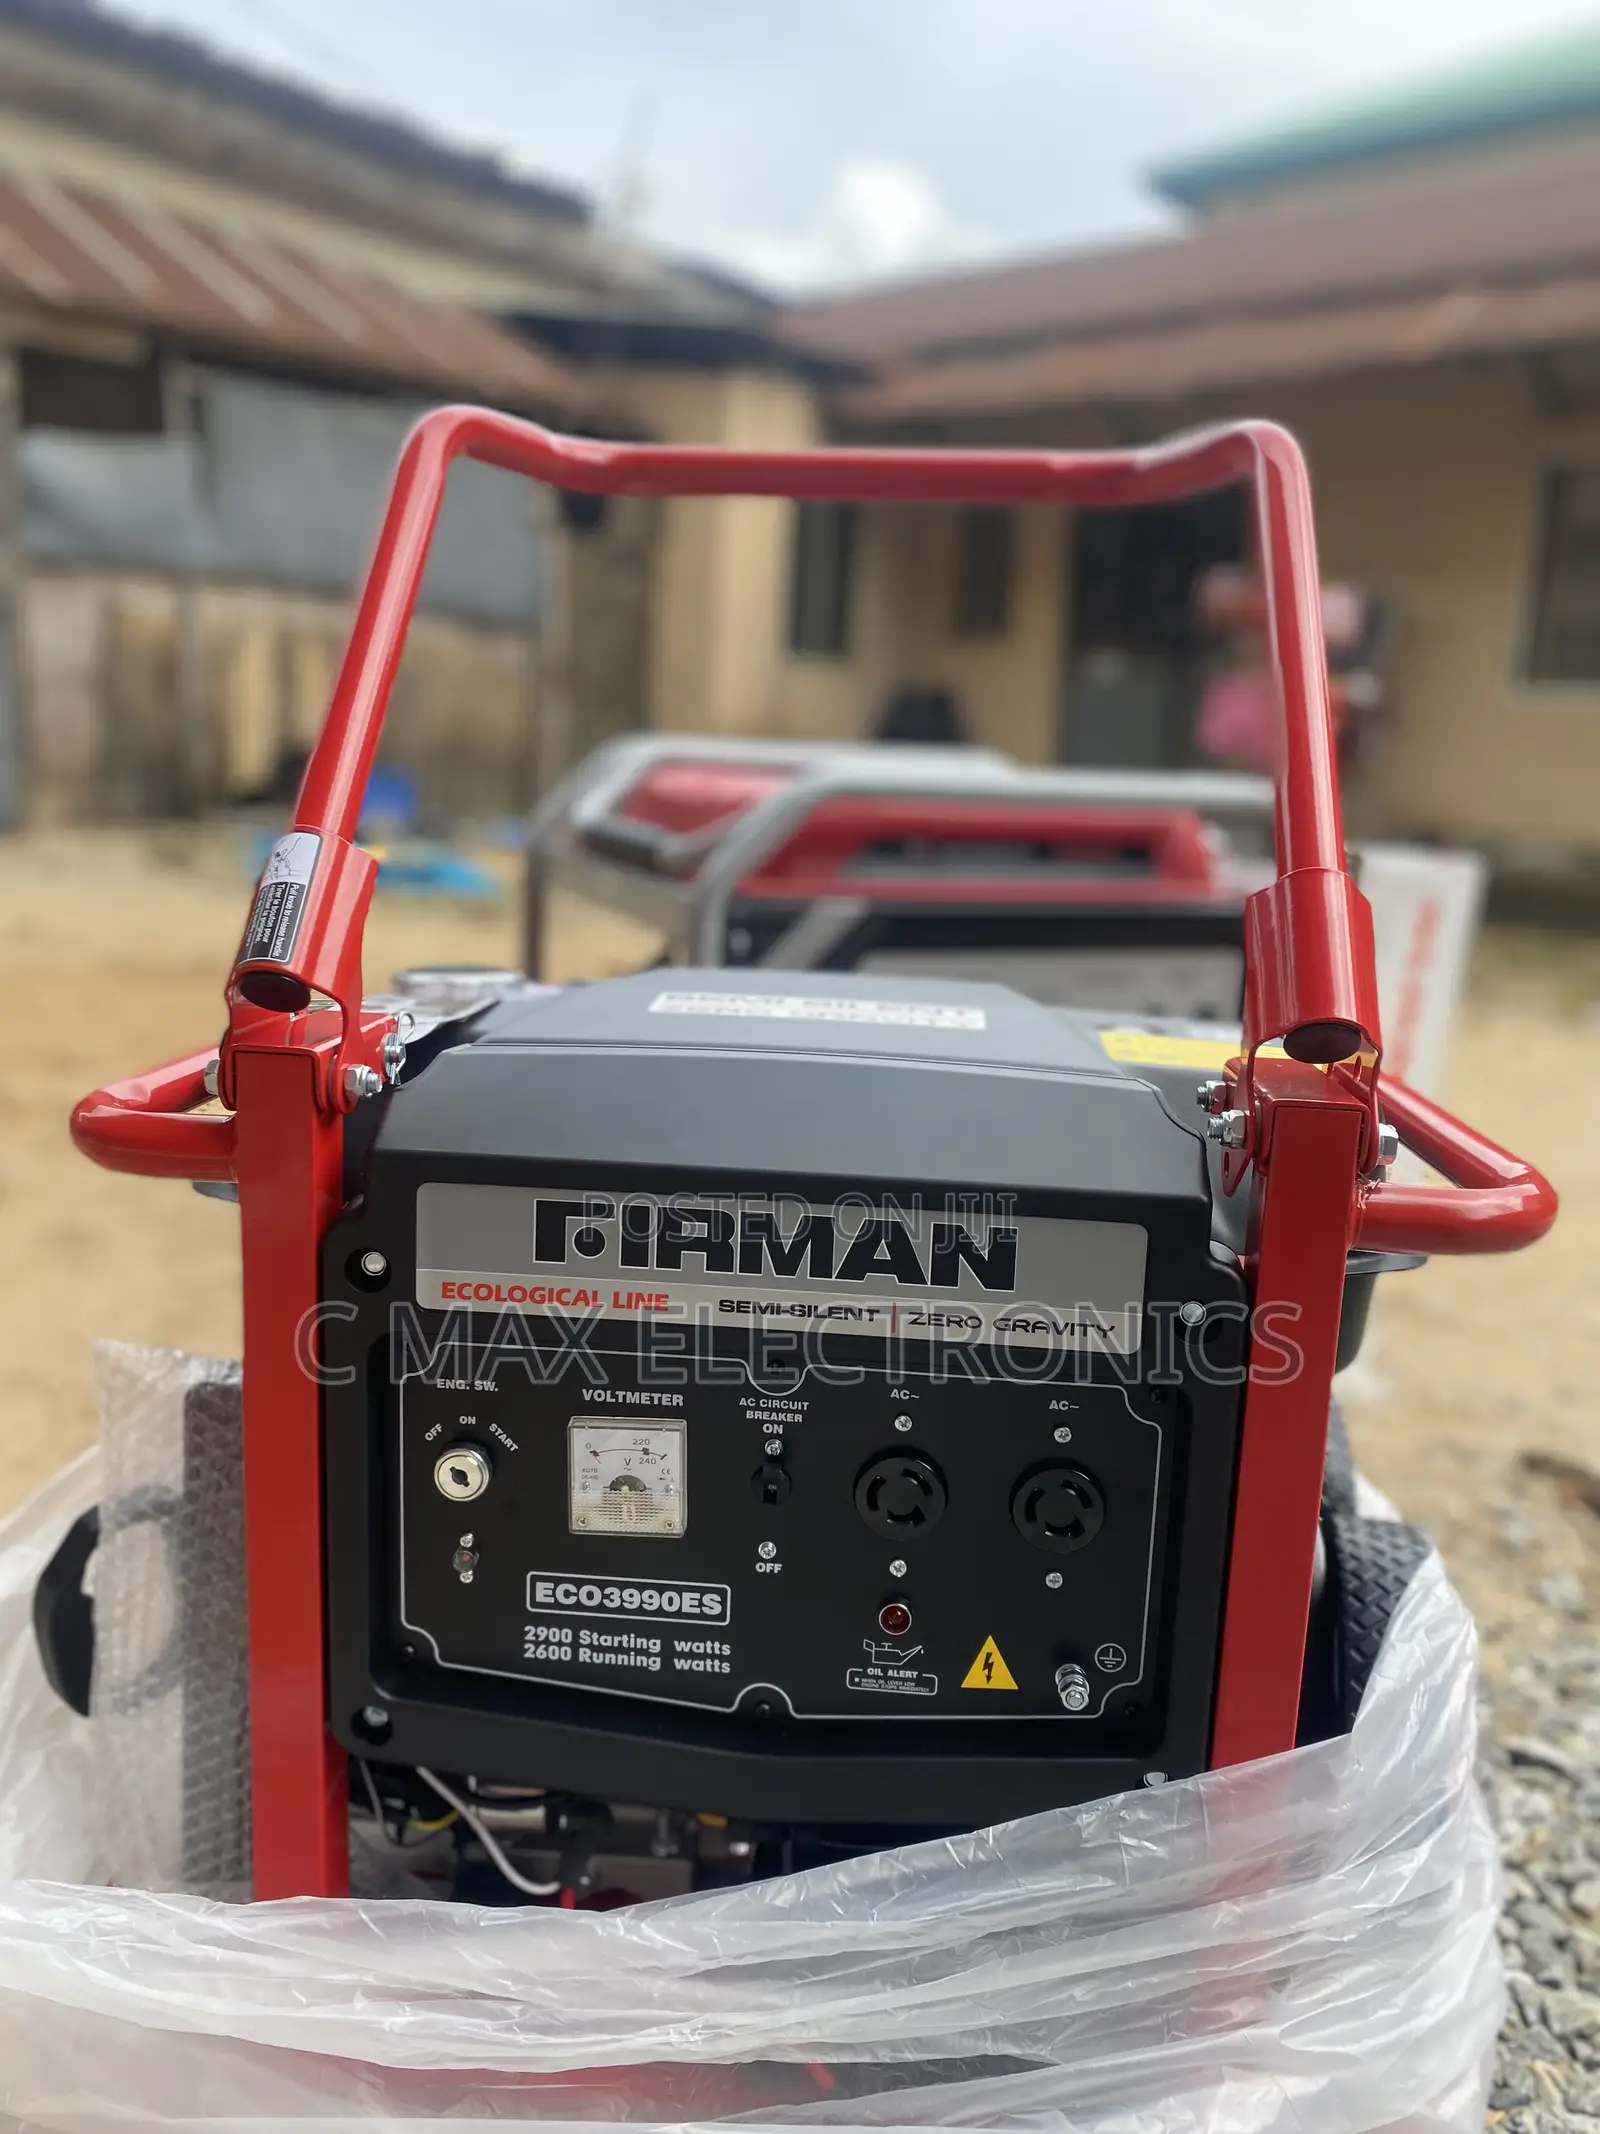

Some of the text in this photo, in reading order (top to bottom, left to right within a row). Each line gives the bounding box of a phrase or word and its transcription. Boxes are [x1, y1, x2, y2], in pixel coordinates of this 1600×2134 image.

[290, 884, 300, 895] Pull
[533, 1198, 1018, 1292] FIRMAN
[441, 1281, 670, 1312] ECOLOGICAL LINE
[718, 1299, 1116, 1338] SEMI-SILENT ZERO GRAVITY
[437, 1378, 498, 1392] ENG. SW.
[582, 1388, 684, 1407] VOLTMETER
[739, 1398, 809, 1410] AC CIRCUIT
[459, 1416, 476, 1424] ON
[746, 1410, 803, 1422] BREAKER
[424, 1423, 442, 1441] OFF
[762, 1423, 783, 1434] ON
[489, 1423, 519, 1451] START
[624, 1458, 631, 1466] V
[755, 1562, 782, 1573] OFF
[536, 1582, 722, 1615] ECO3990ES
[524, 1626, 731, 1656] 2900 Starting watts
[523, 1644, 731, 1673] 2600 Running watts
[867, 1668, 918, 1678] OIL ALERT
